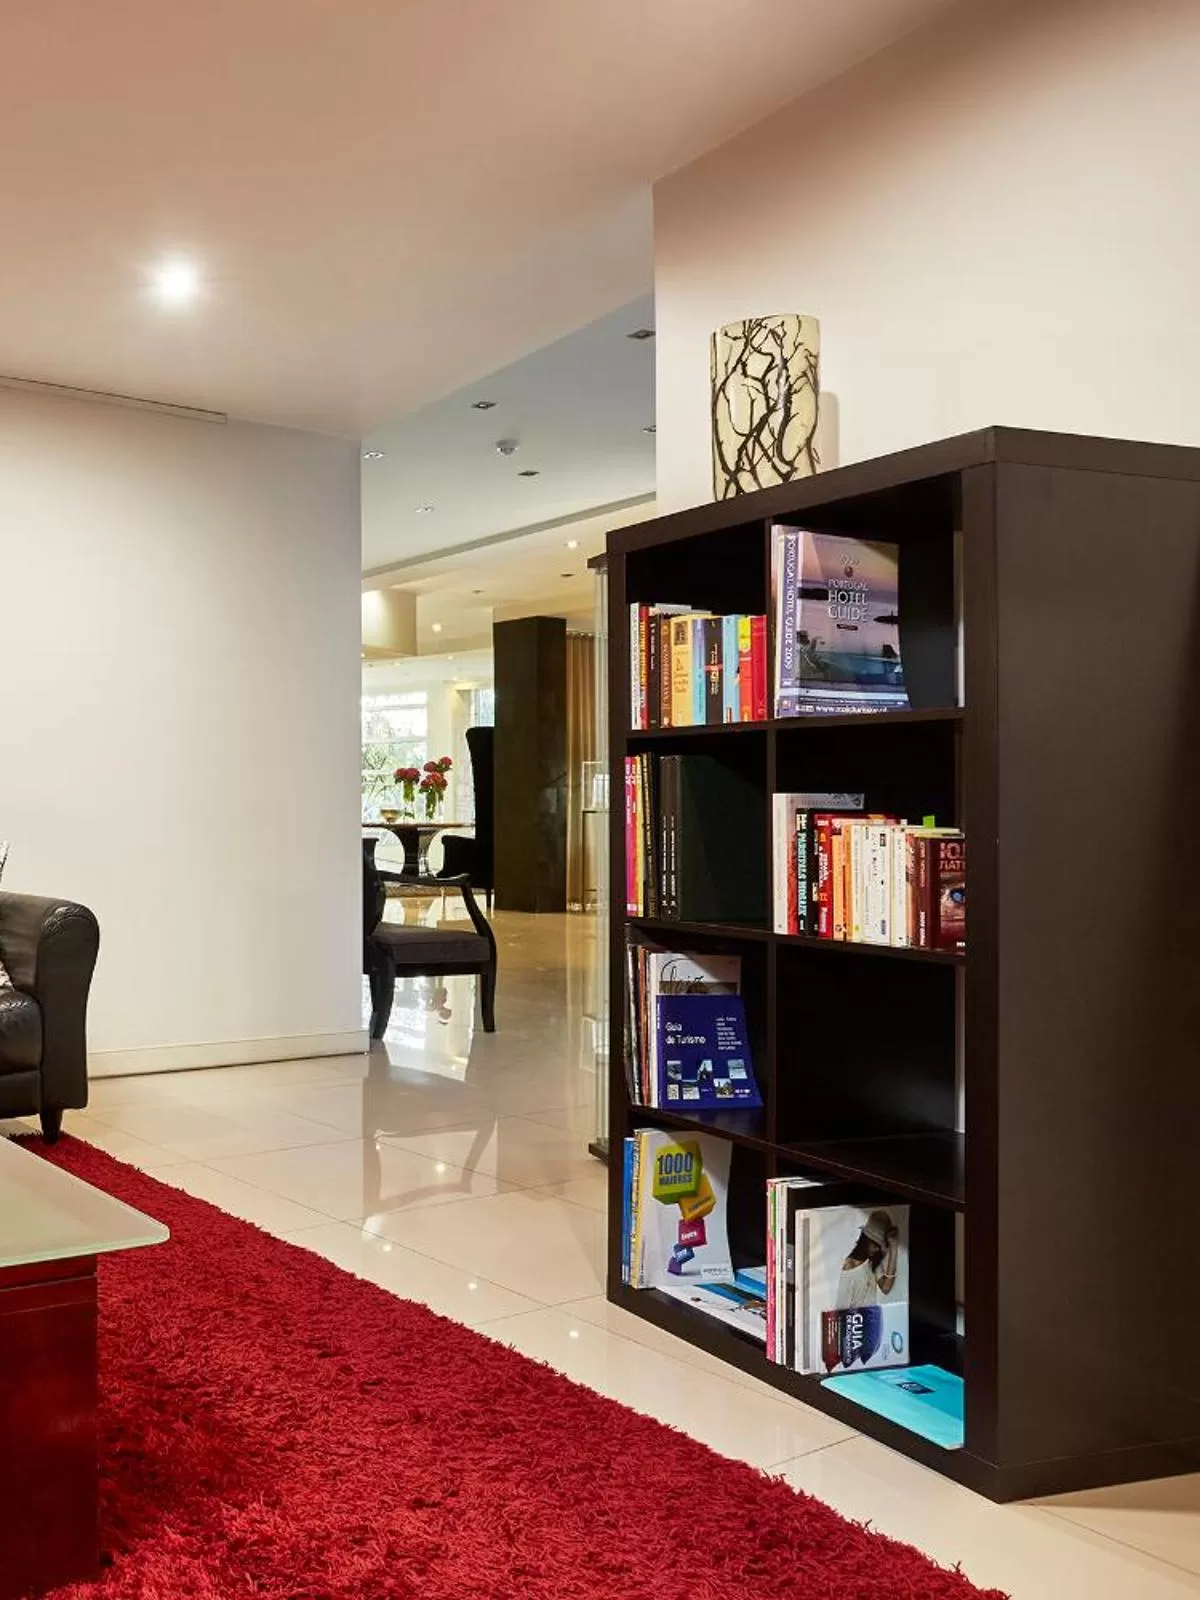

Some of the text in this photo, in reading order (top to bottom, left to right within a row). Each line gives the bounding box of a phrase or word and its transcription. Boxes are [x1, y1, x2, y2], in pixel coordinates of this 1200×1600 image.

[827, 577, 869, 591] PORTUGAL
[827, 591, 869, 606] HOTEL
[827, 605, 869, 622] GUIDE
[665, 1022, 683, 1032] Guia
[665, 1035, 706, 1045] de Turismo
[657, 1152, 693, 1174] 1000
[851, 1313, 864, 1350] GUIA
